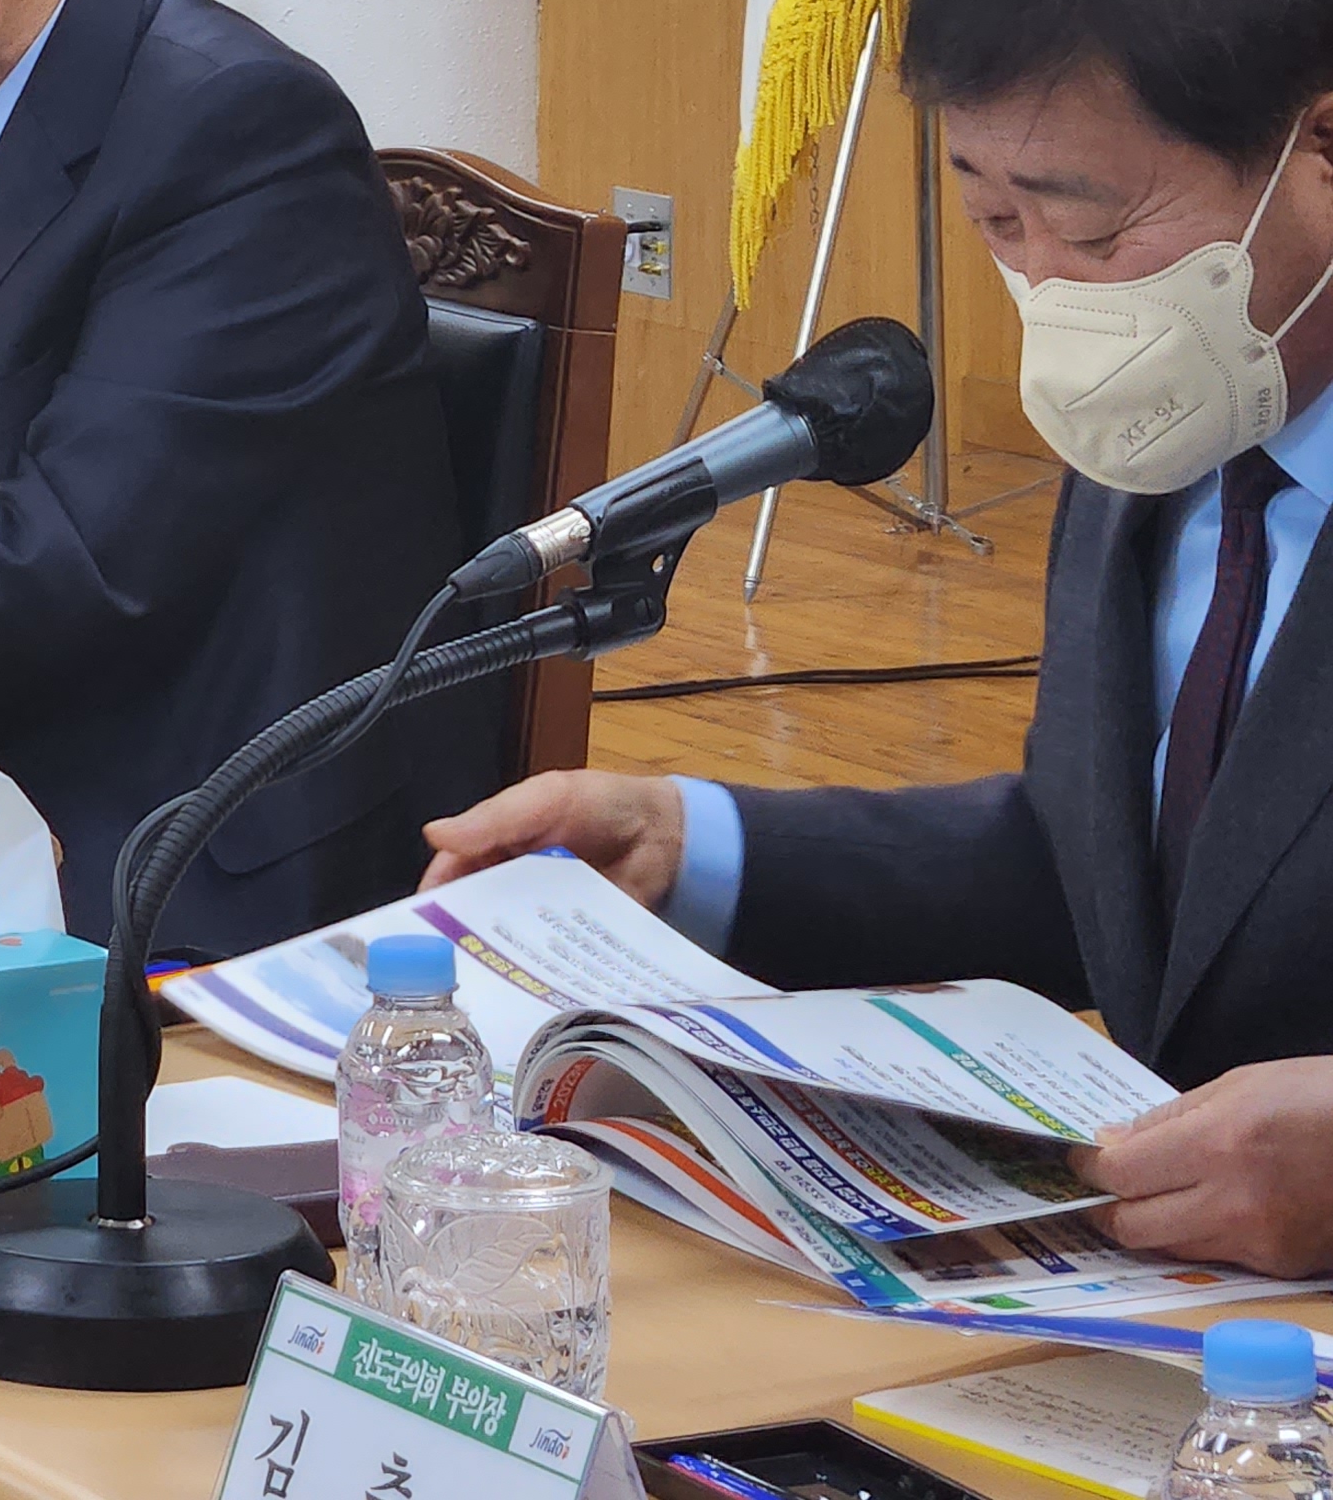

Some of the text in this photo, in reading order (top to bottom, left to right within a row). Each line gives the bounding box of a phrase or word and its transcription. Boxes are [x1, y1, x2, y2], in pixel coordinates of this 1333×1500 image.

[1118, 396, 1183, 447] KF-94
[352, 1337, 507, 1437] 진도군의회 부의장
[254, 1408, 311, 1499] 김
